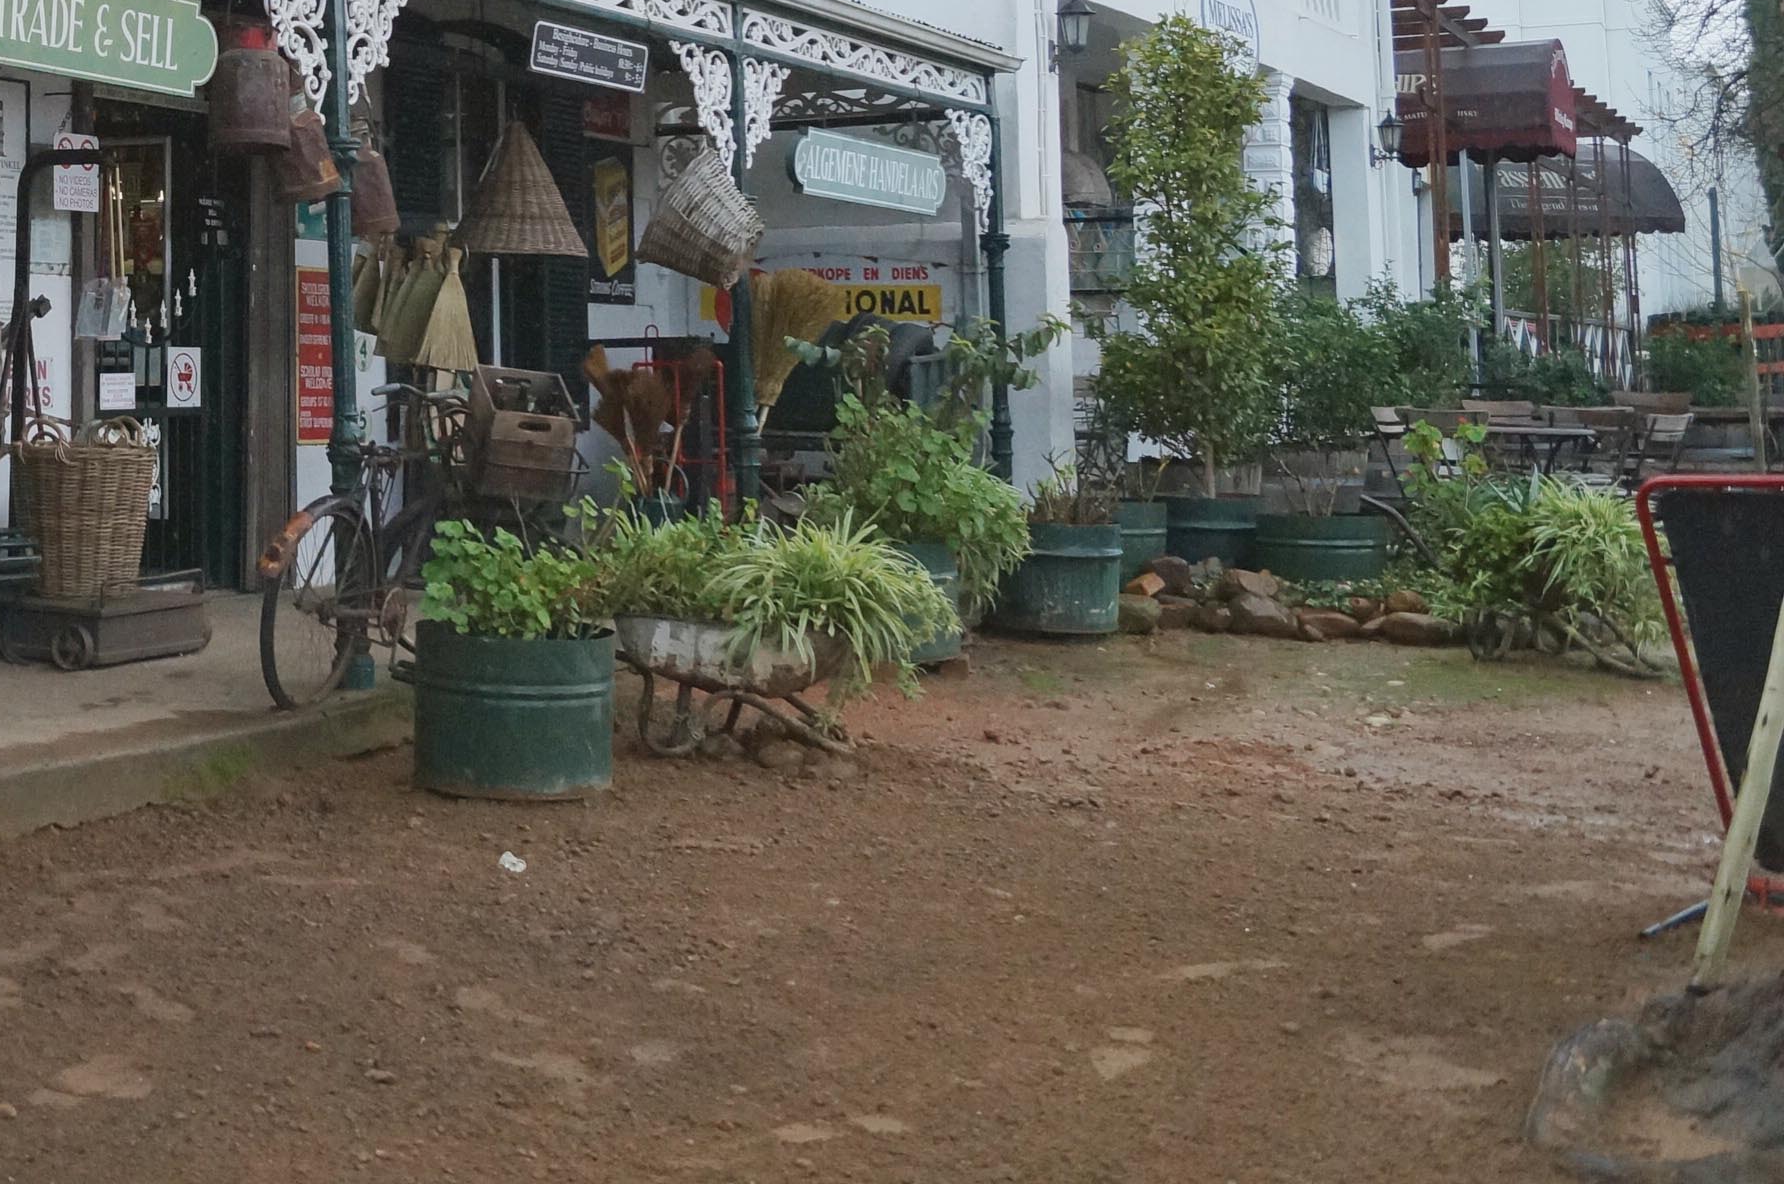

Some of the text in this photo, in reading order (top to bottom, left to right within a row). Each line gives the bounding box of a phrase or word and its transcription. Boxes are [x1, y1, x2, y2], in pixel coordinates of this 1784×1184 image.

[94, 4, 113, 57] &
[119, 9, 178, 71] SELL
[59, 175, 68, 185] NO
[804, 146, 939, 201] ALGEMENE HANDELAARS
[59, 186, 97, 198] NO CAMERAS
[59, 197, 94, 209] NO PHOTOS
[863, 267, 879, 280] EN
[892, 266, 929, 280] DIENS
